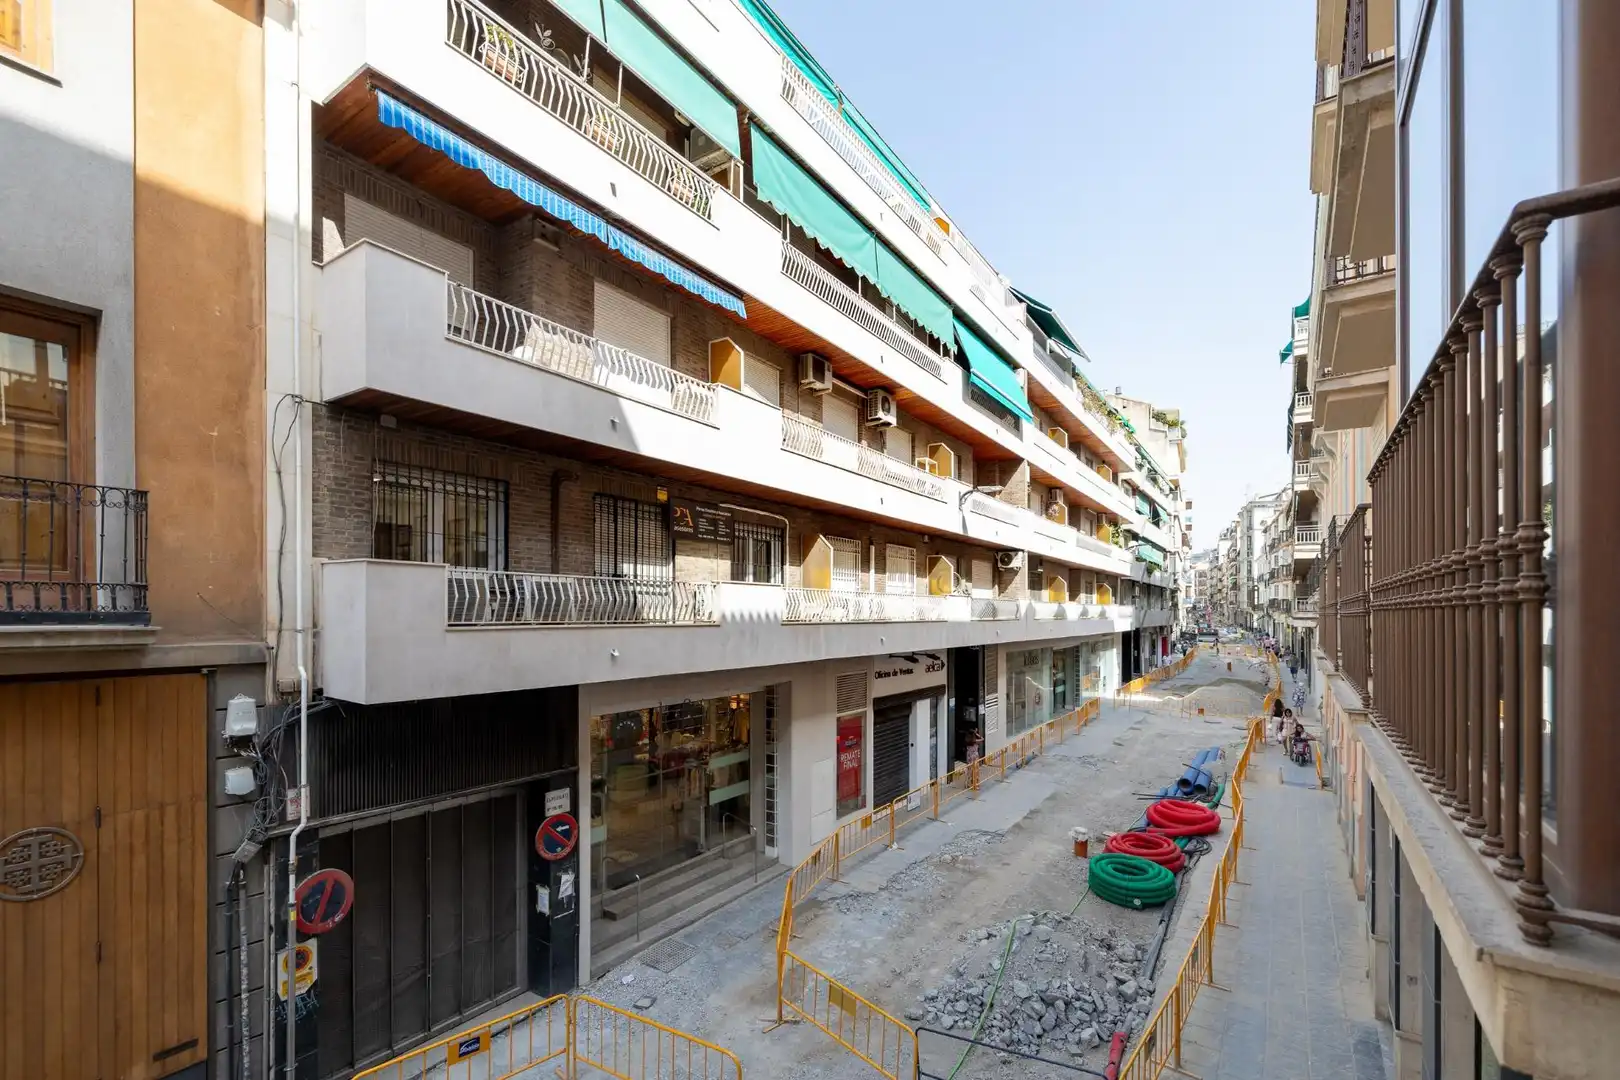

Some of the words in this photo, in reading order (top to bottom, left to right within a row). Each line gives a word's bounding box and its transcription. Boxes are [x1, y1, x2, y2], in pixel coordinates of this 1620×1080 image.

[874, 670, 891, 679] Oficina
[892, 669, 898, 677] de
[899, 668, 914, 676] Ventas
[840, 749, 861, 761] REMATE
[843, 759, 859, 770] FINAL
